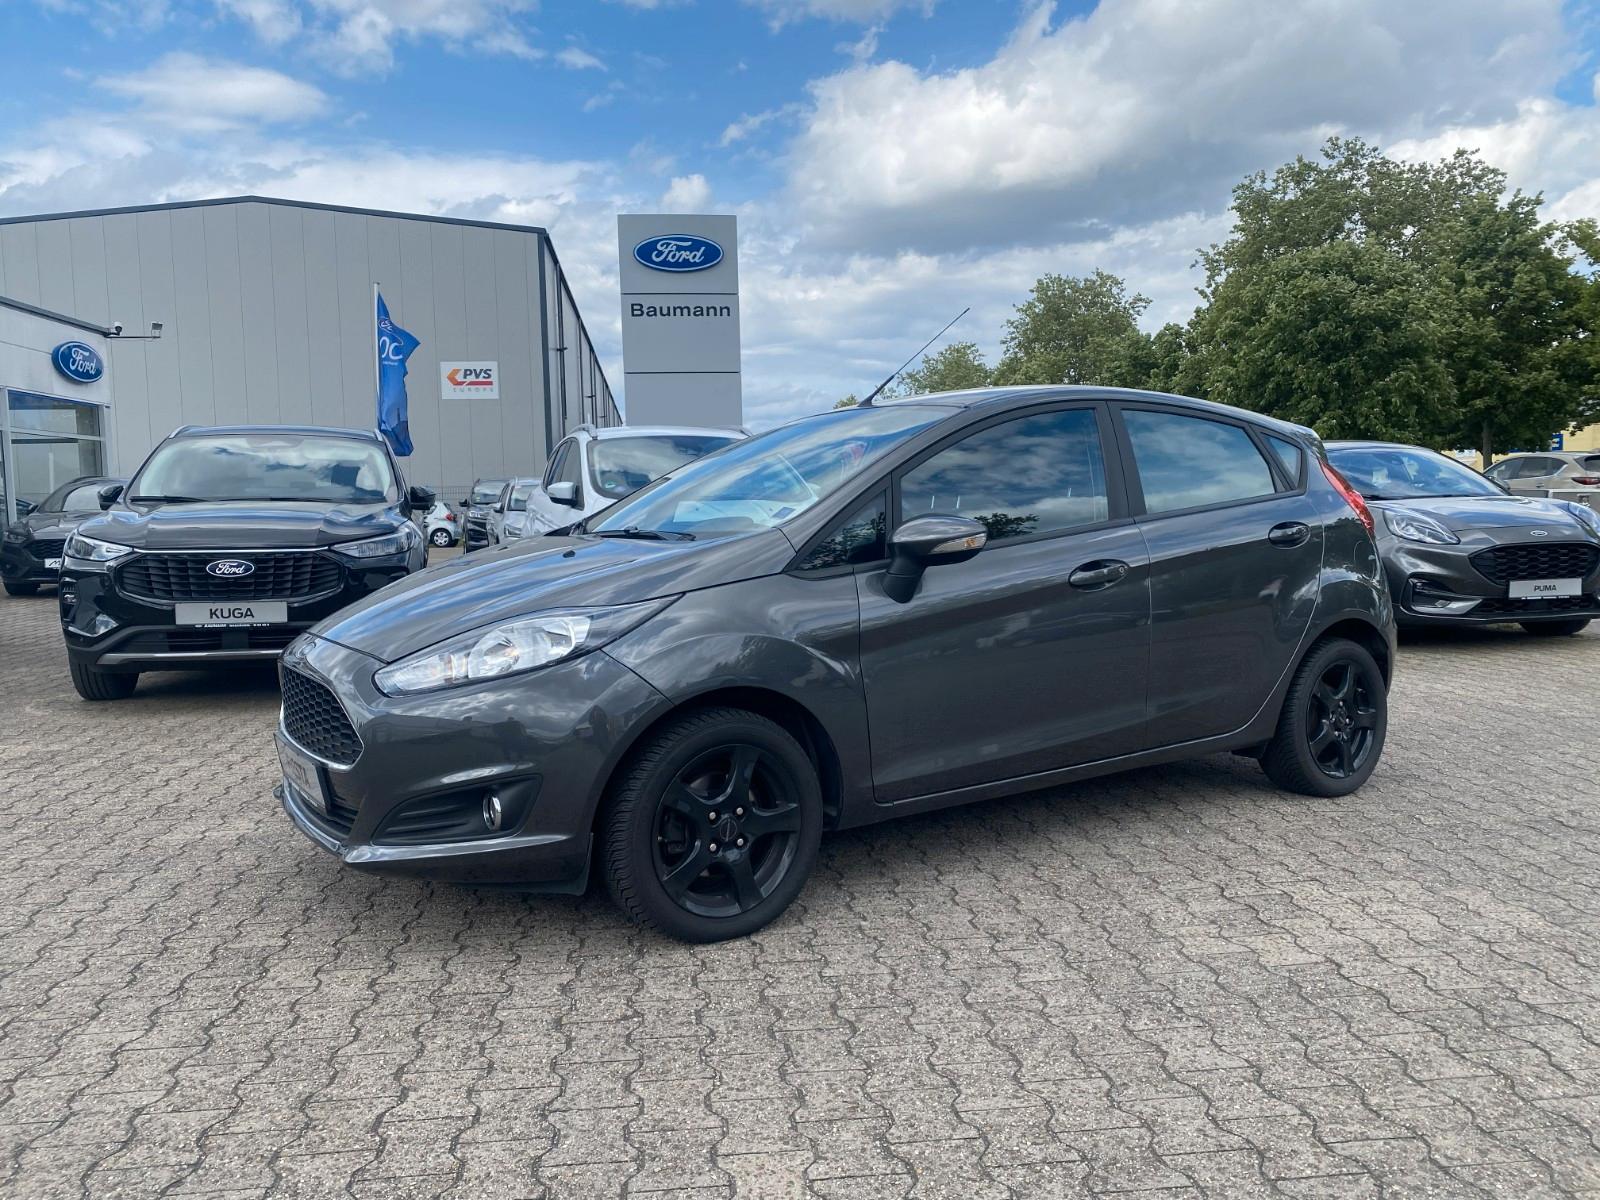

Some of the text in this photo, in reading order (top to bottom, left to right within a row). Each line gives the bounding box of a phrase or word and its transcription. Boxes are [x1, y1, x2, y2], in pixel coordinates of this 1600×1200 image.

[651, 240, 706, 263] Ford
[630, 303, 731, 317] Baumann
[69, 347, 97, 375] Ford
[463, 368, 492, 380] PVS
[215, 562, 246, 574] Ford
[1533, 584, 1557, 592] PUMA
[209, 607, 255, 620] KUGA
